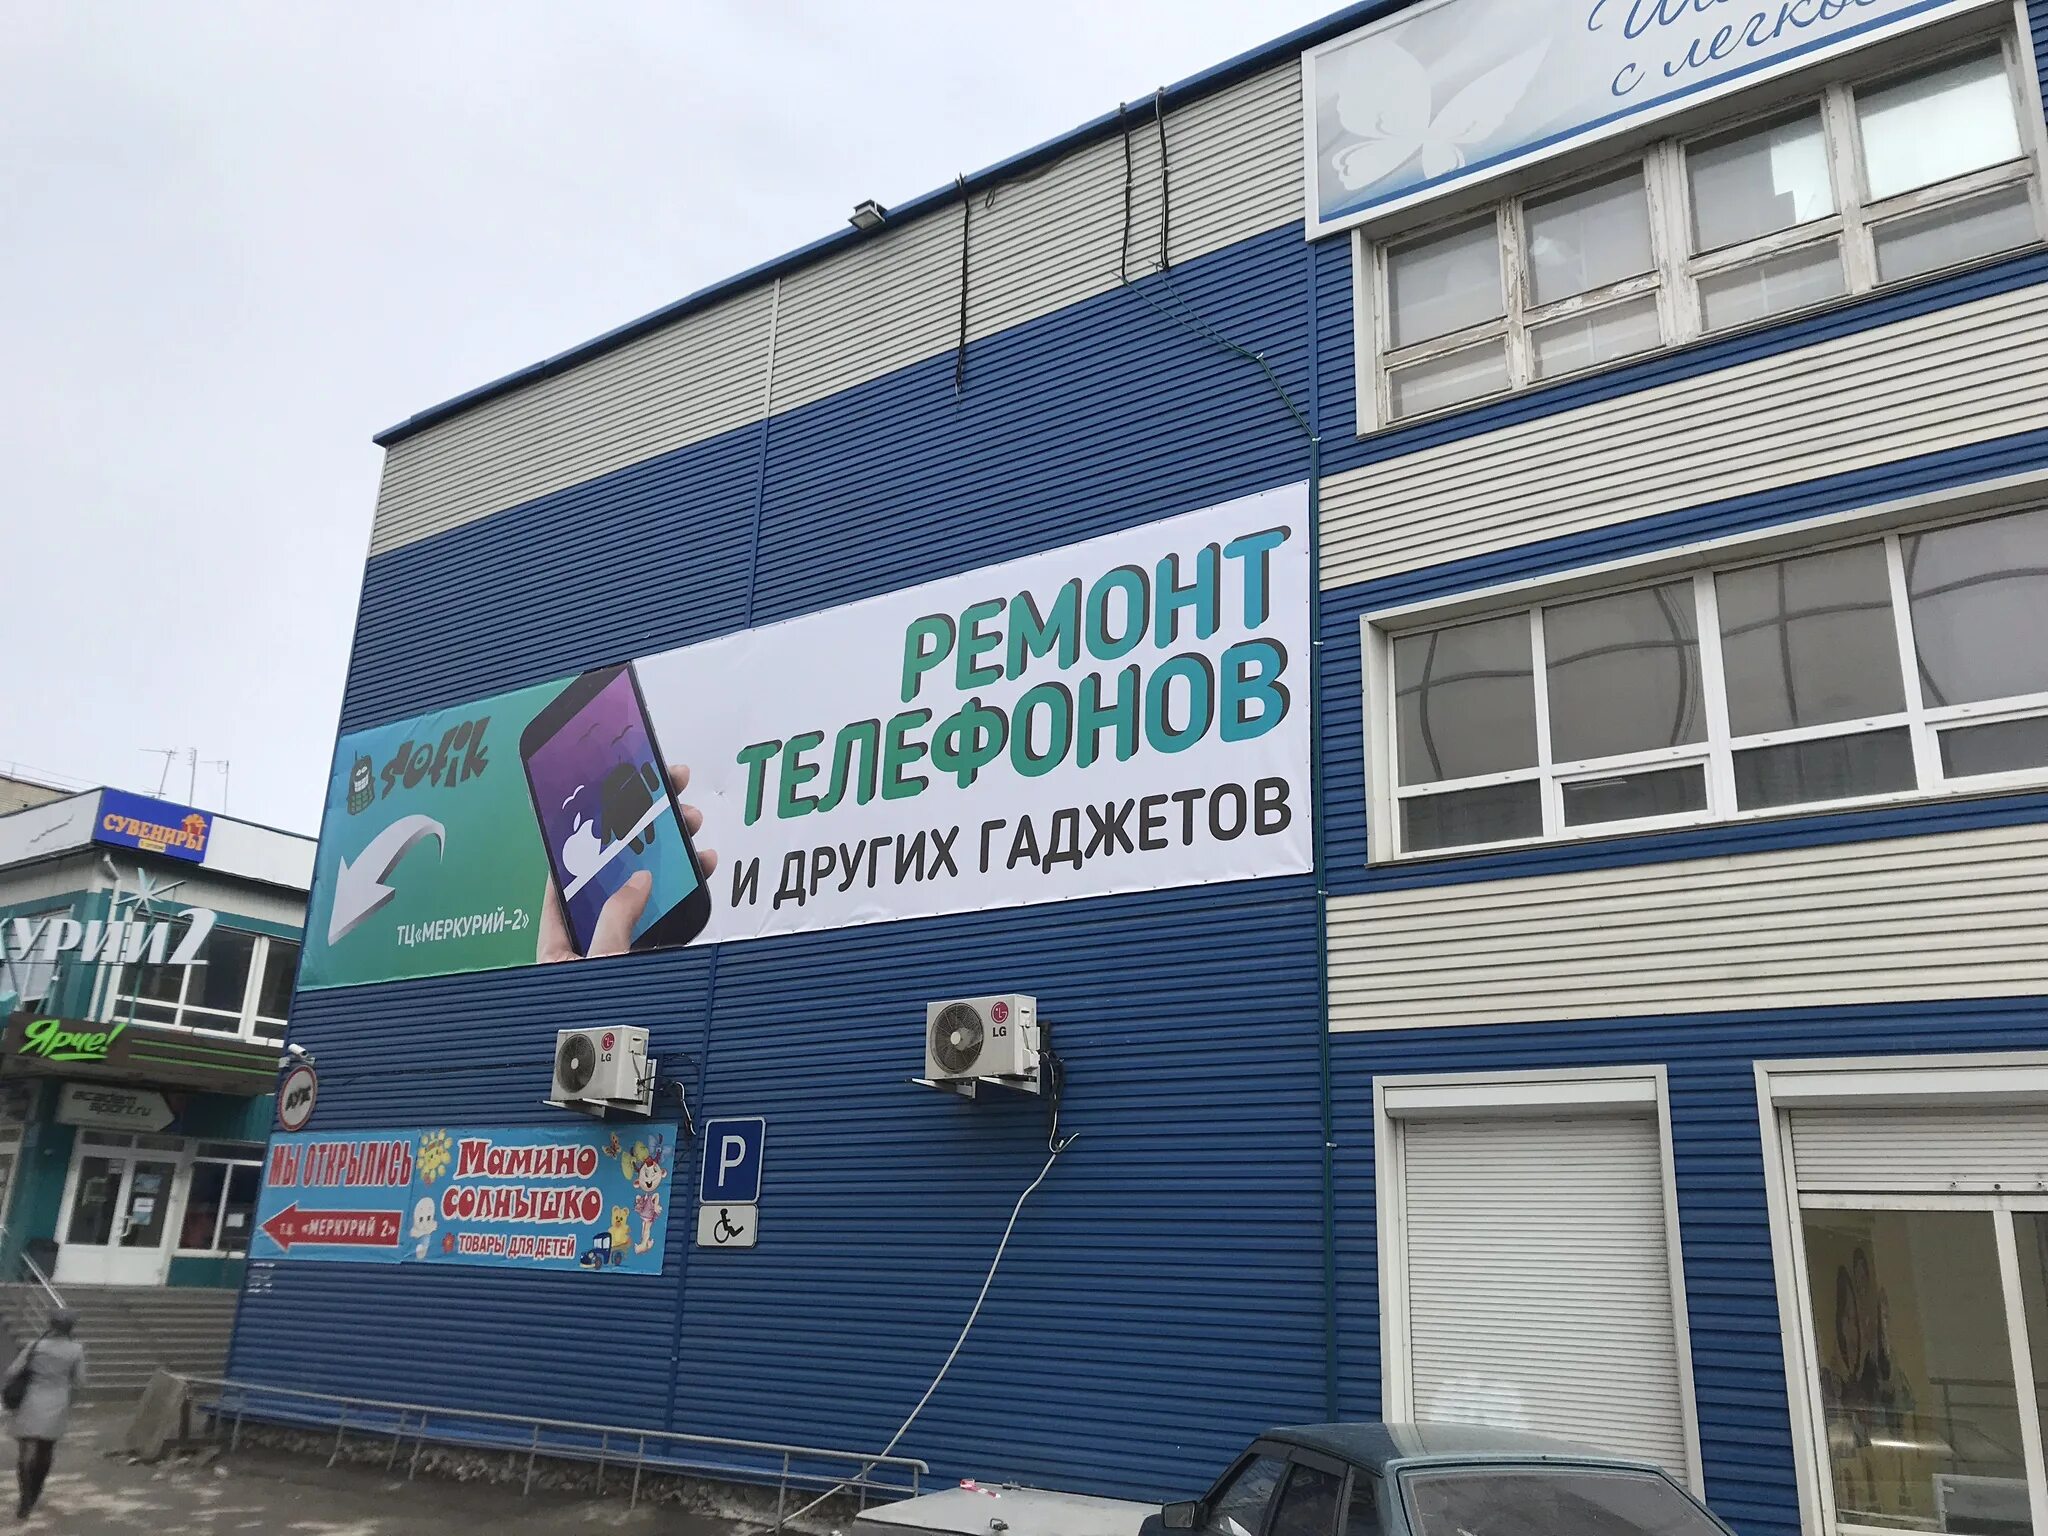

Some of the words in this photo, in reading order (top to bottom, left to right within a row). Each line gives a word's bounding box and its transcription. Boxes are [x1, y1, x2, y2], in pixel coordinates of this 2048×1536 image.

[901, 525, 1291, 703] РЕМОНТ
[737, 637, 1288, 826] ТЕЛЕФОНОВ
[103, 814, 205, 851] СУВЕНИРЫ
[731, 858, 760, 908] И
[773, 826, 959, 910] ДРУГИХ
[979, 777, 1292, 874] ГАДЖЕТОВ
[17, 1019, 127, 1057] Ярче!
[992, 1026, 1007, 1038] LG
[600, 1053, 612, 1062] LG
[267, 1143, 303, 1188] МЫ
[302, 1140, 413, 1188] ОТКРЫЛИСЬ
[453, 1138, 599, 1180] Мамино
[717, 1135, 746, 1187] P
[458, 1233, 506, 1255] ТОВАРЫ
[507, 1234, 534, 1258] ДЛЯ
[534, 1234, 576, 1259] ДЕТЕЙ
